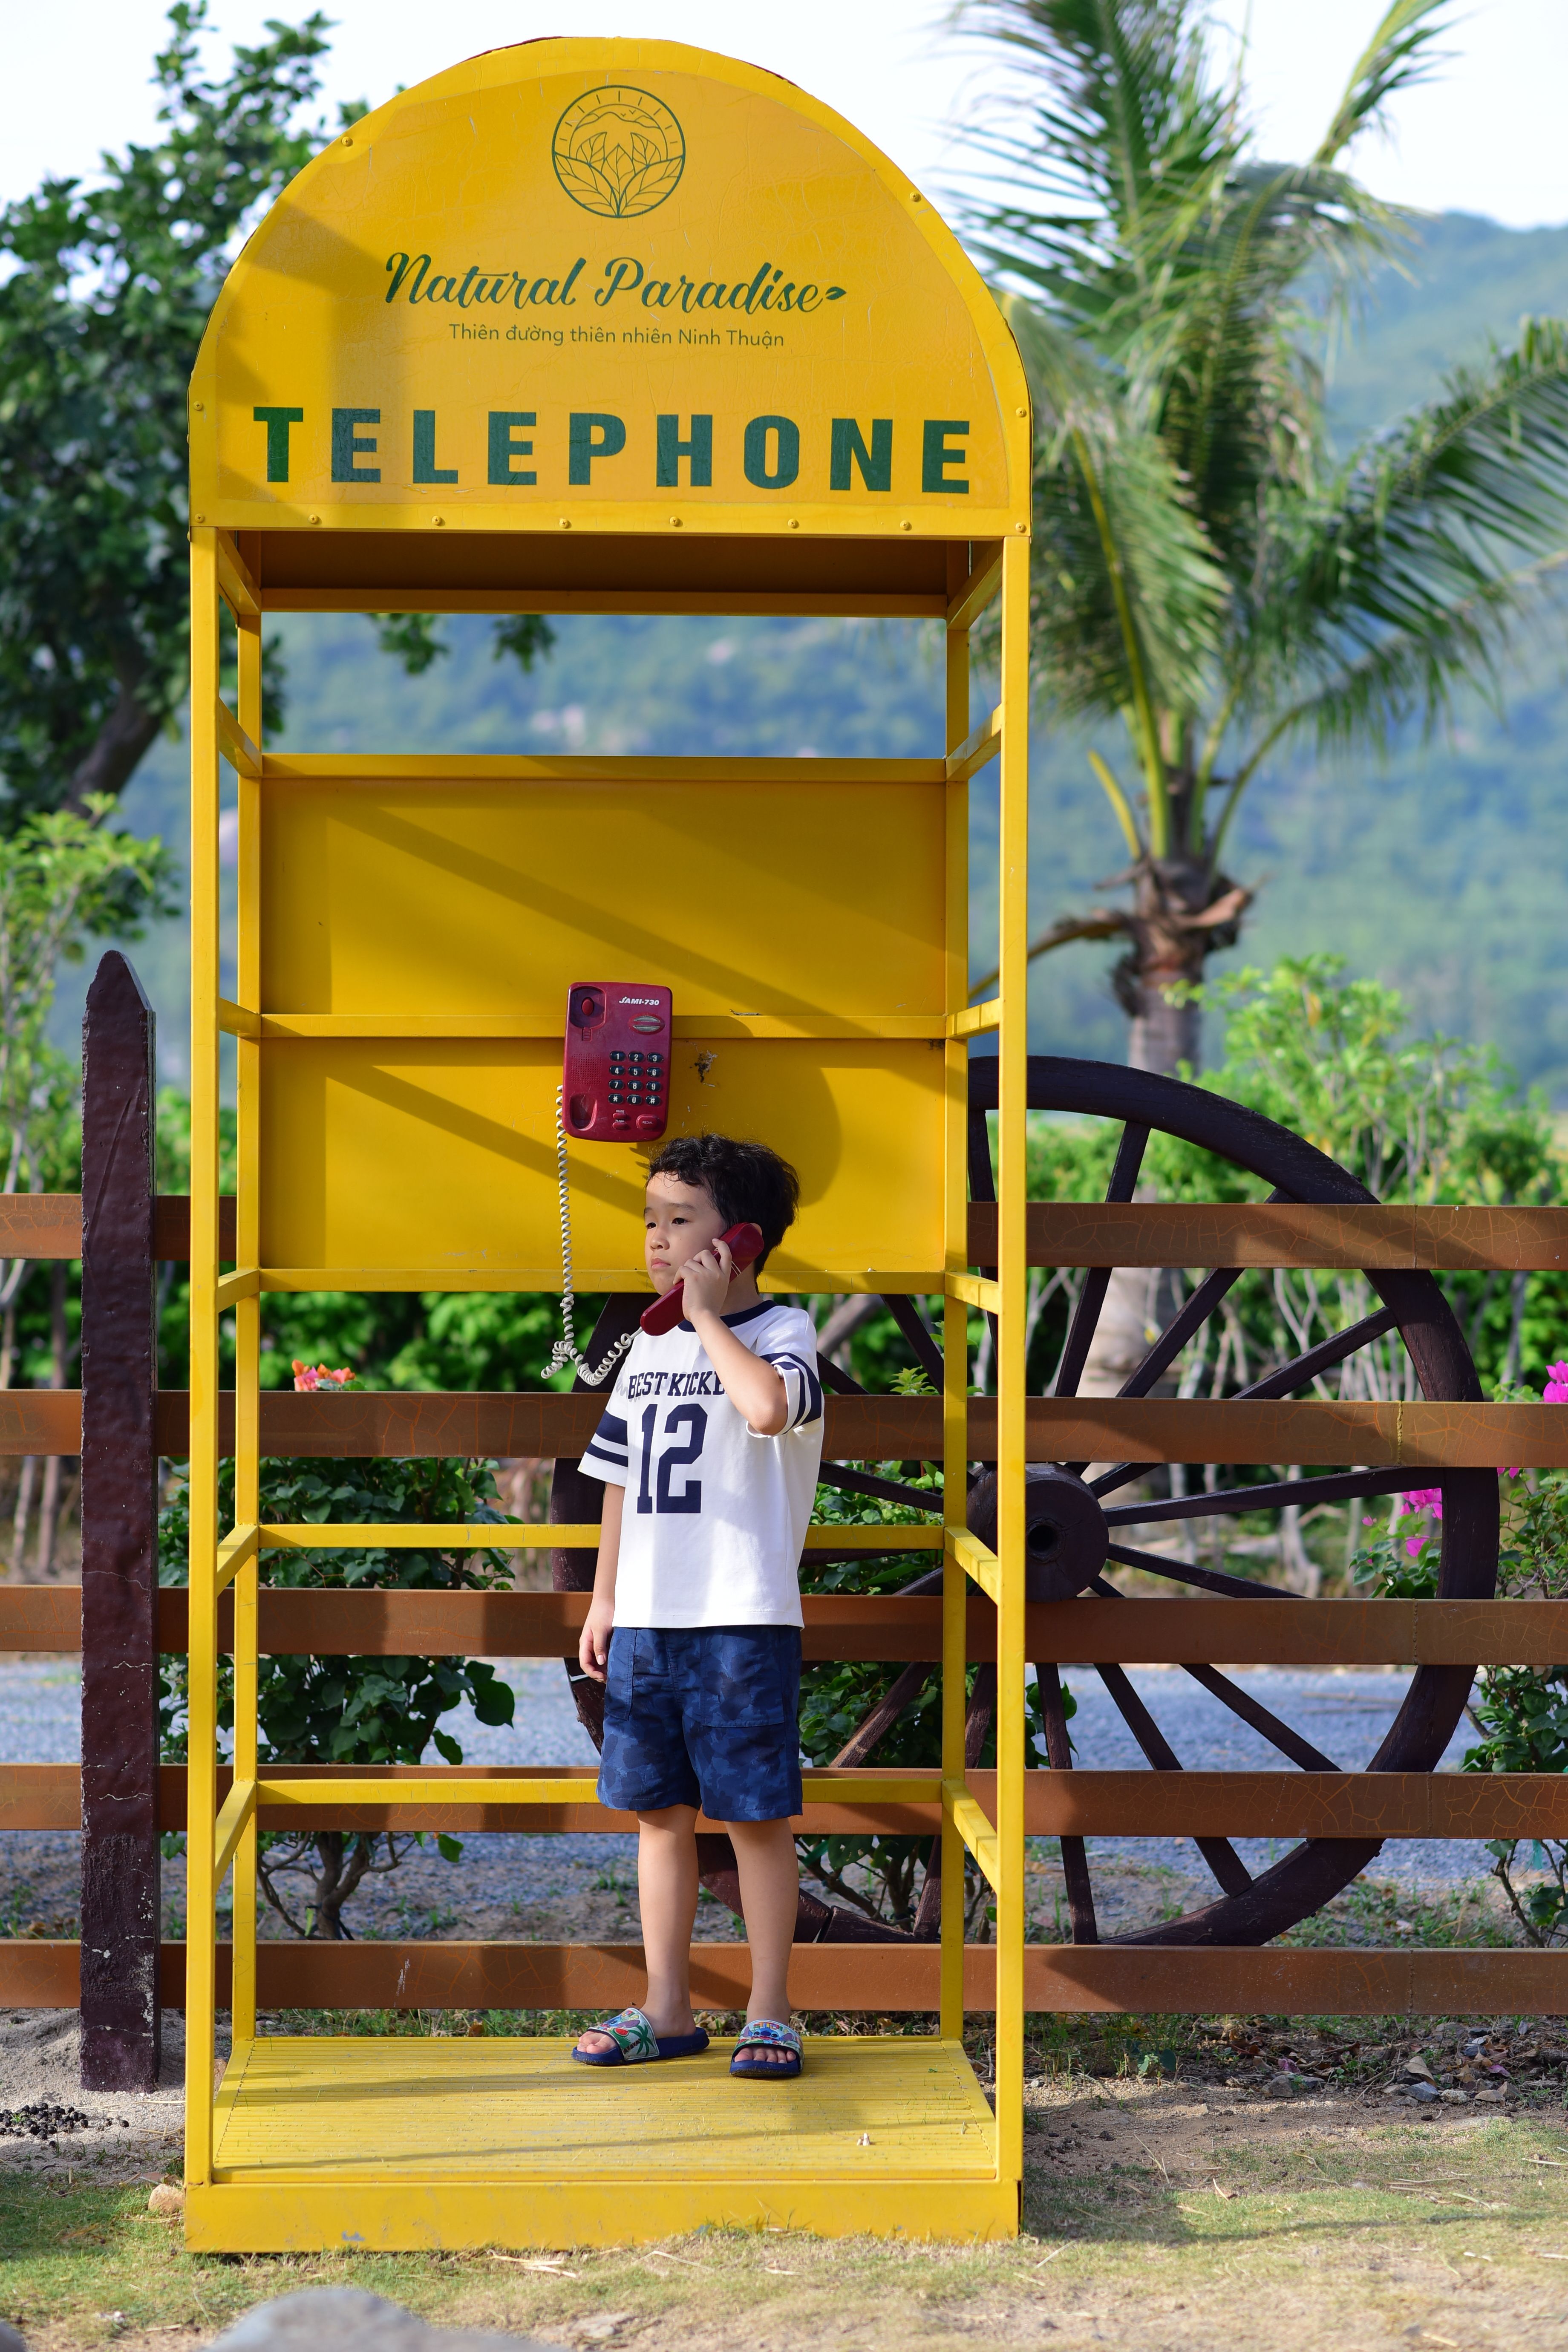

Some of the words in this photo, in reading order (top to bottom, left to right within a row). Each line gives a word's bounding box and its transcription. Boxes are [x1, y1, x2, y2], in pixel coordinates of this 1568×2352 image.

[385, 252, 585, 310] Natural
[594, 257, 824, 315] Paradise
[449, 323, 499, 340] Thiên
[505, 324, 564, 346] đường
[570, 325, 616, 343] thiên
[623, 326, 672, 344] nhiên
[679, 328, 721, 345] Ninh
[726, 329, 784, 349] Thuận
[253, 406, 970, 494] TELEPHONE
[619, 996, 660, 1006] JAMI-730
[628, 1372, 669, 1399] BEST
[637, 1403, 708, 1514] 12
